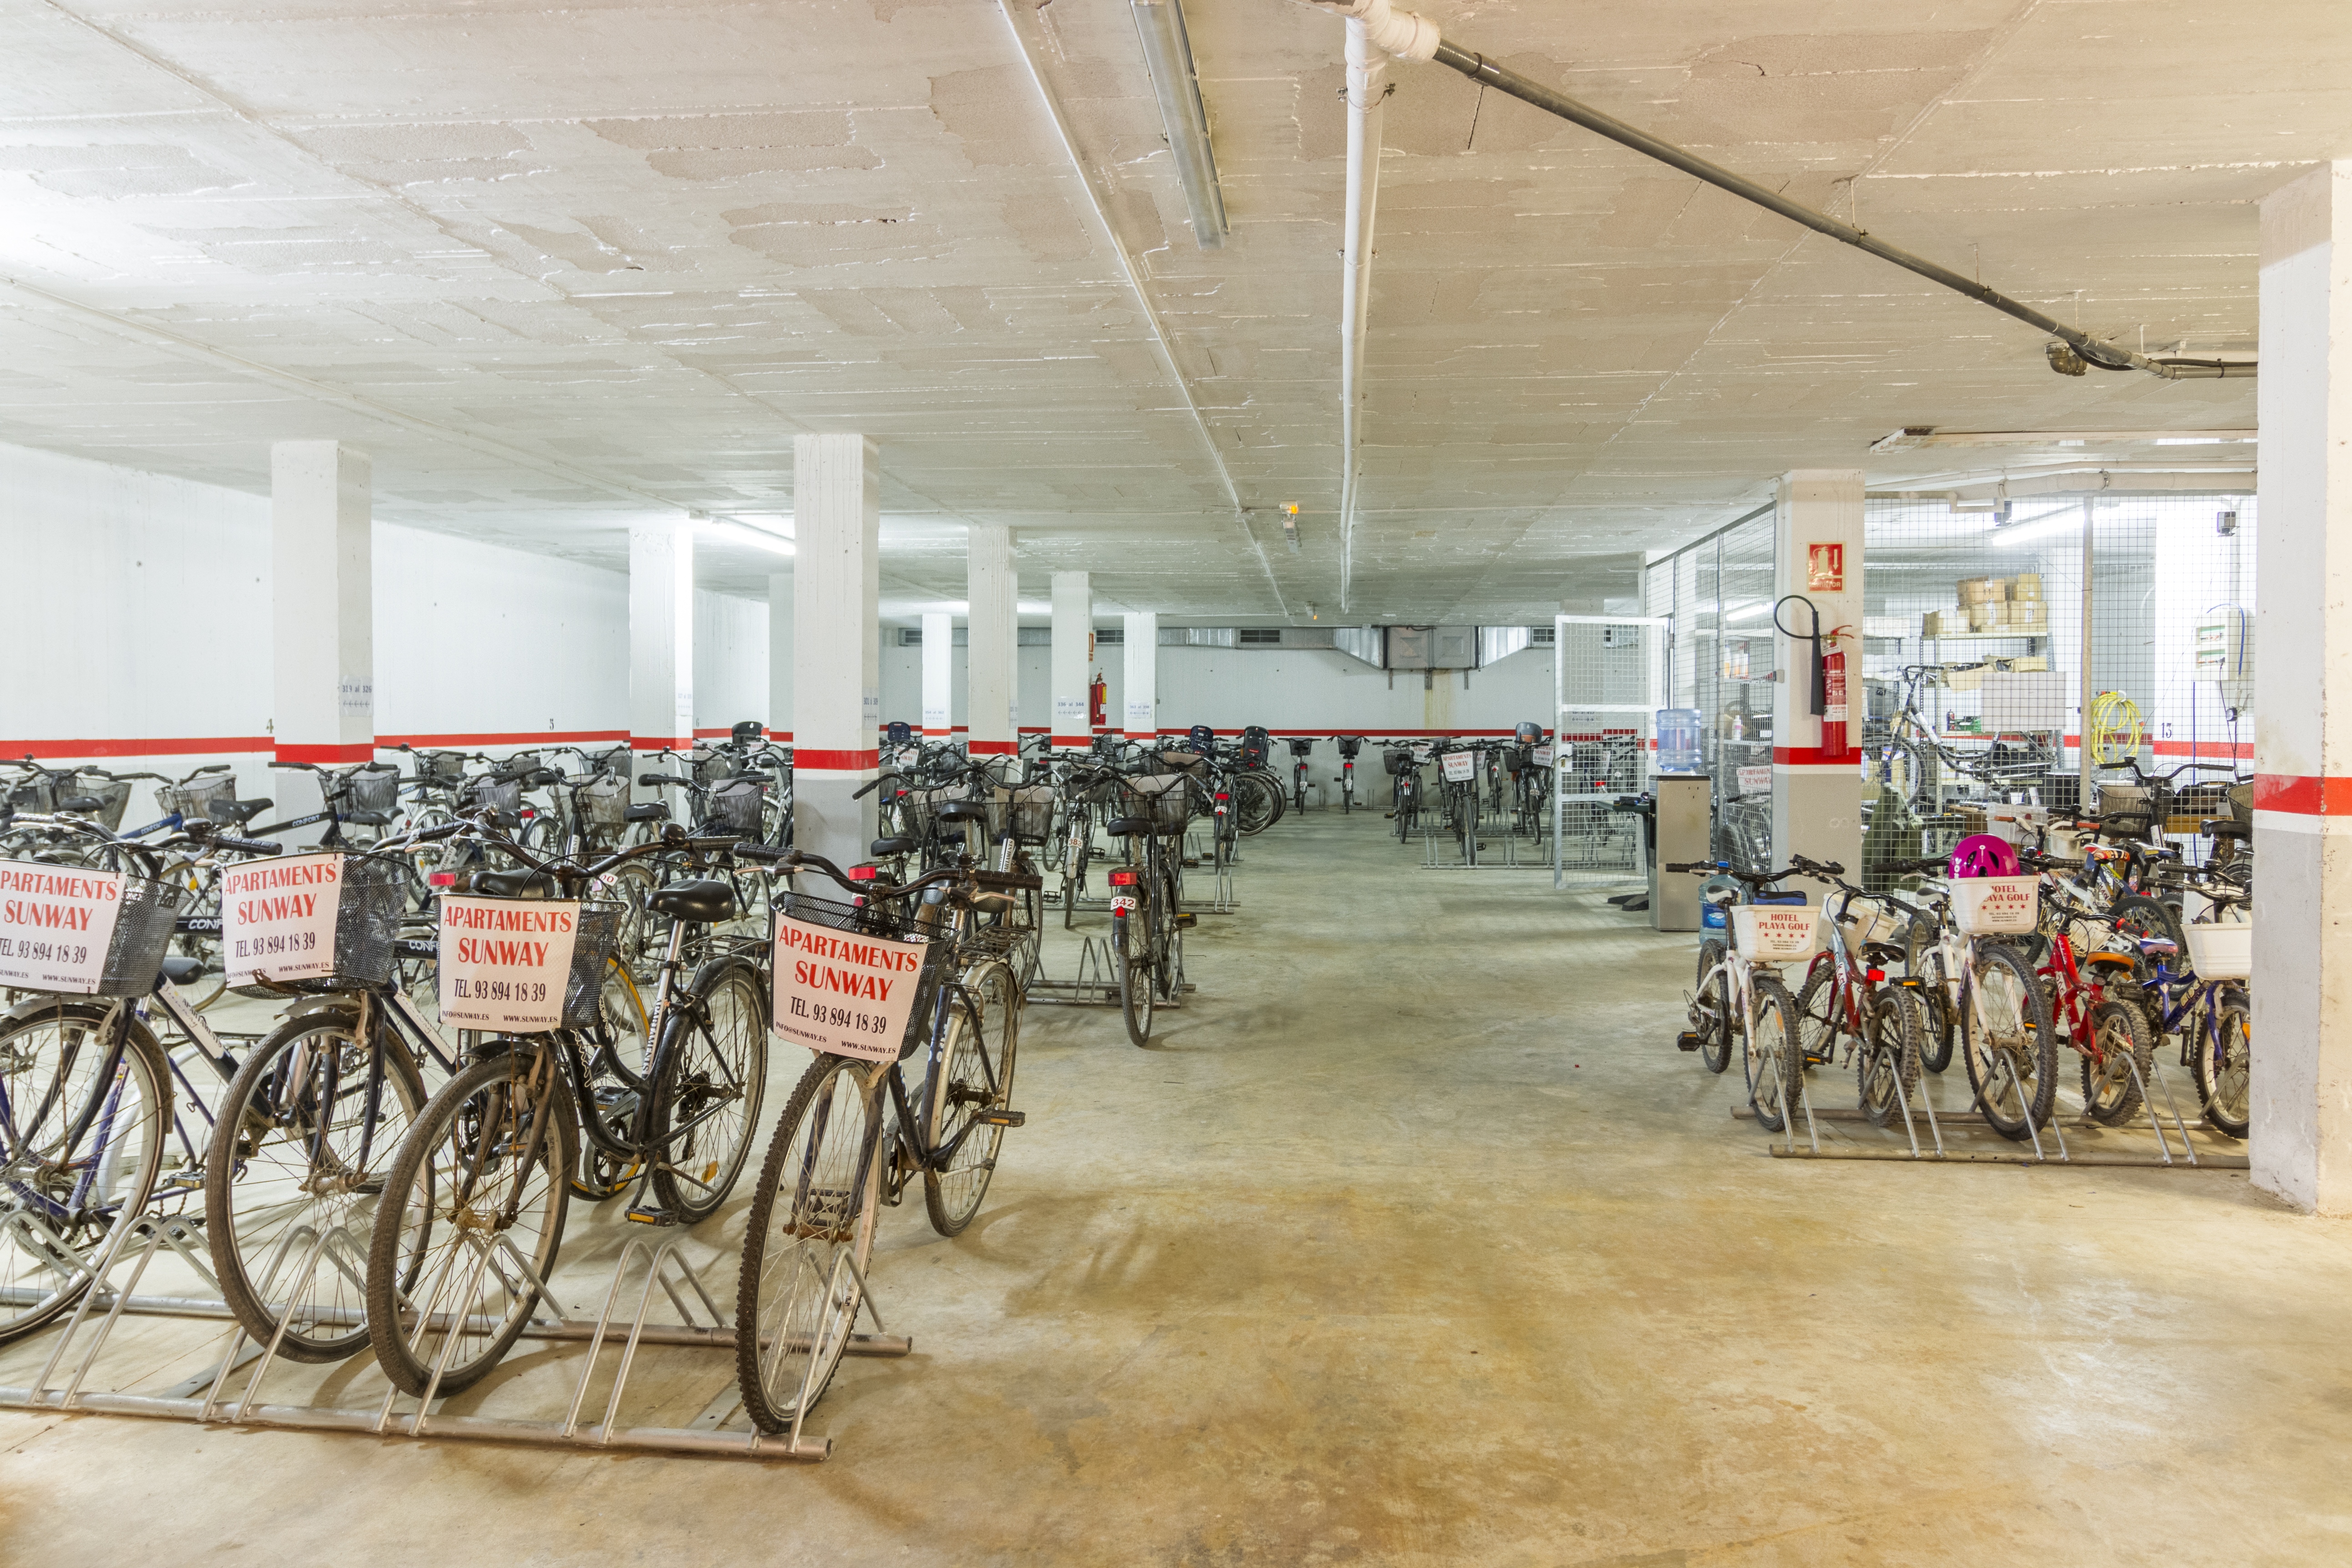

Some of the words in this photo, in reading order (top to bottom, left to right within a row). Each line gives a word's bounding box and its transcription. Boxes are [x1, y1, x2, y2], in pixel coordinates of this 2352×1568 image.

[266, 719, 274, 734] 4
[549, 718, 554, 730] 5
[696, 718, 700, 727] 6
[2161, 722, 2172, 738] 13
[292, 815, 320, 827] CONFORT
[1069, 839, 1081, 847] 383
[0, 870, 117, 901] PARTAMENTS
[225, 863, 336, 896] APARTAMENTS
[2101, 865, 2125, 888] CONOR
[238, 893, 317, 925] SUNWAY
[1113, 898, 1134, 908] 342
[4, 900, 93, 931] SUNWAY
[189, 919, 222, 929] CONF
[444, 906, 572, 933] APARTAMENTS
[1771, 913, 1799, 922] HOTEL
[1759, 922, 1785, 930] PLAYA
[17, 940, 30, 958] 93
[32, 942, 52, 961] 894
[57, 945, 70, 963] 18
[72, 946, 87, 964] 39
[253, 937, 264, 956] 93
[267, 935, 285, 954] 894
[289, 933, 300, 952] 18
[302, 932, 315, 950] 39
[409, 940, 439, 952] CONF
[458, 938, 549, 967] SUNWAY
[779, 925, 918, 972] APARTAMENTS
[278, 962, 330, 973] WWW.SUNWAY.ES
[42, 974, 96, 985] WWW.SUNWAY.ES
[795, 960, 893, 1001] SUNWAY
[455, 978, 471, 998] TEL.
[475, 980, 488, 999] 93
[491, 981, 510, 1000] 894
[515, 983, 528, 1001] 18
[531, 983, 546, 1001] 39
[442, 1010, 489, 1021] INFO@SUNWAY.ES
[503, 1014, 558, 1023] WWW.SUNWAY.ES
[791, 996, 809, 1018] TEL.
[813, 1004, 827, 1023] 93
[830, 1008, 851, 1028] 894
[856, 1013, 868, 1031] 18
[871, 1016, 886, 1034] 39
[776, 1021, 827, 1043] INFO@SUNWAY.ES
[841, 1040, 896, 1054] WWW.SUNWAY.ES
